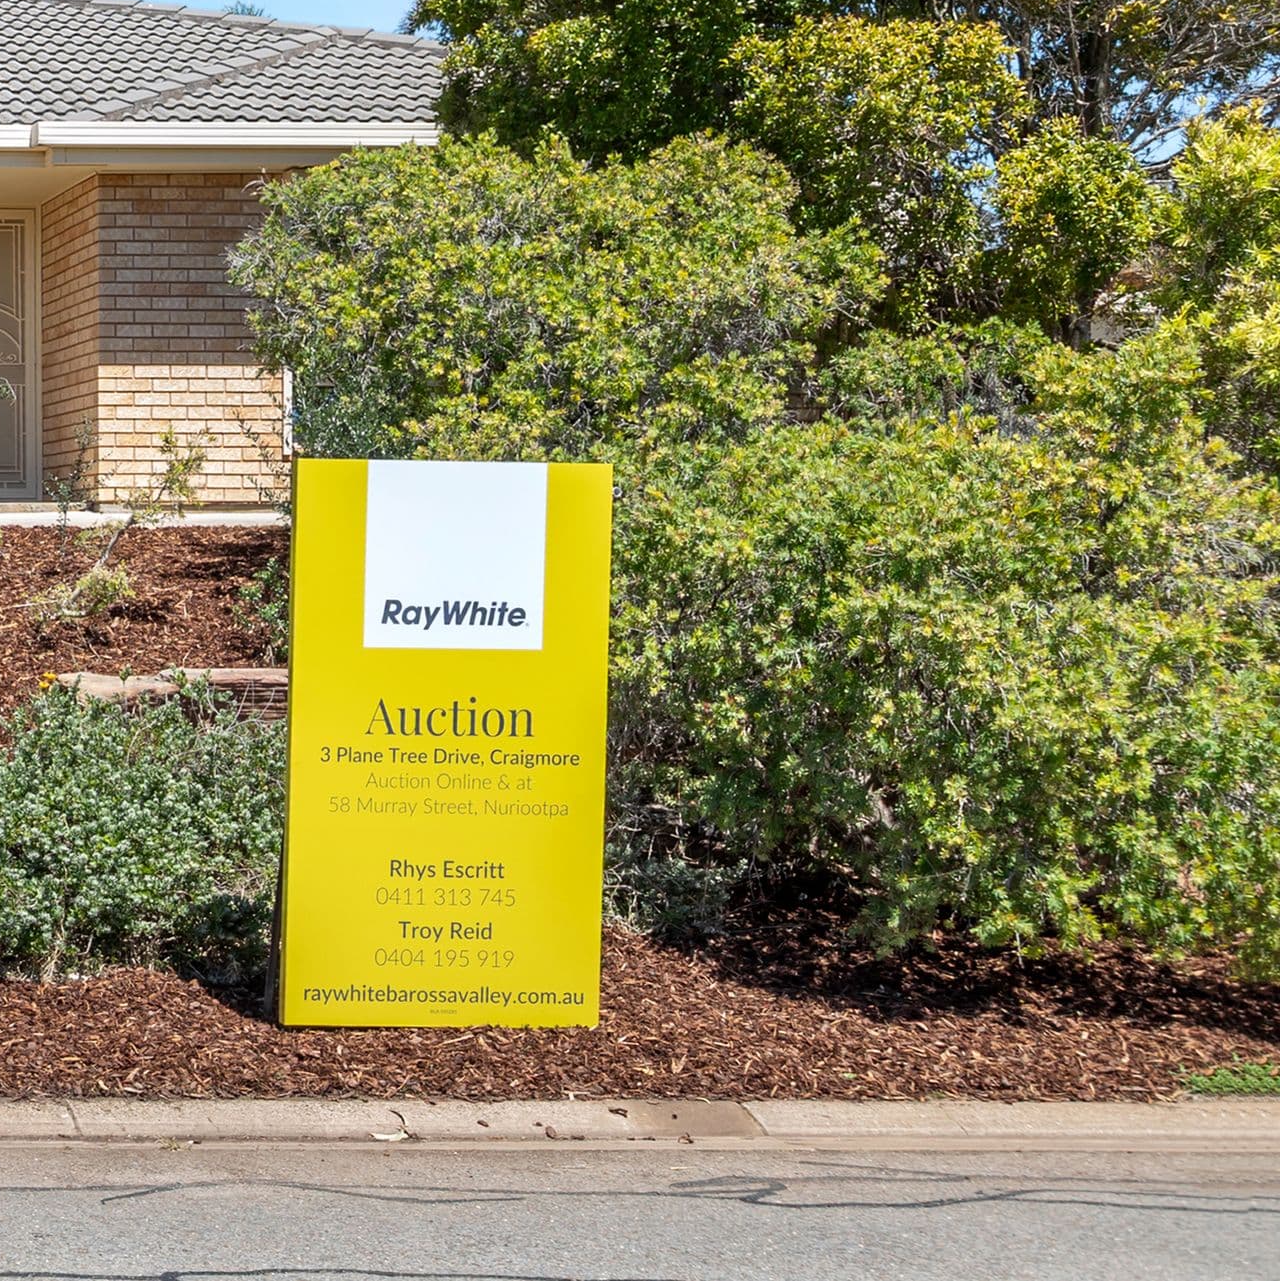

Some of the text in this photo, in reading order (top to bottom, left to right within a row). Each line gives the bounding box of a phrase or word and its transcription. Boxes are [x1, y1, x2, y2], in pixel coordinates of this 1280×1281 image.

[365, 697, 534, 737] Auction
[321, 747, 580, 768] 3 Plane Tree Drive, Craigmore
[366, 773, 532, 790] Auction Online & at
[330, 797, 568, 819] 58 Murray Street, Nuriootpa
[390, 859, 504, 881] Rhys Escritt
[376, 887, 515, 907] 0411 313 745
[398, 921, 492, 943] Troy Reid
[375, 948, 514, 968] 0404 195 919
[304, 984, 584, 1007] raywhitebarossavalley.com.au
